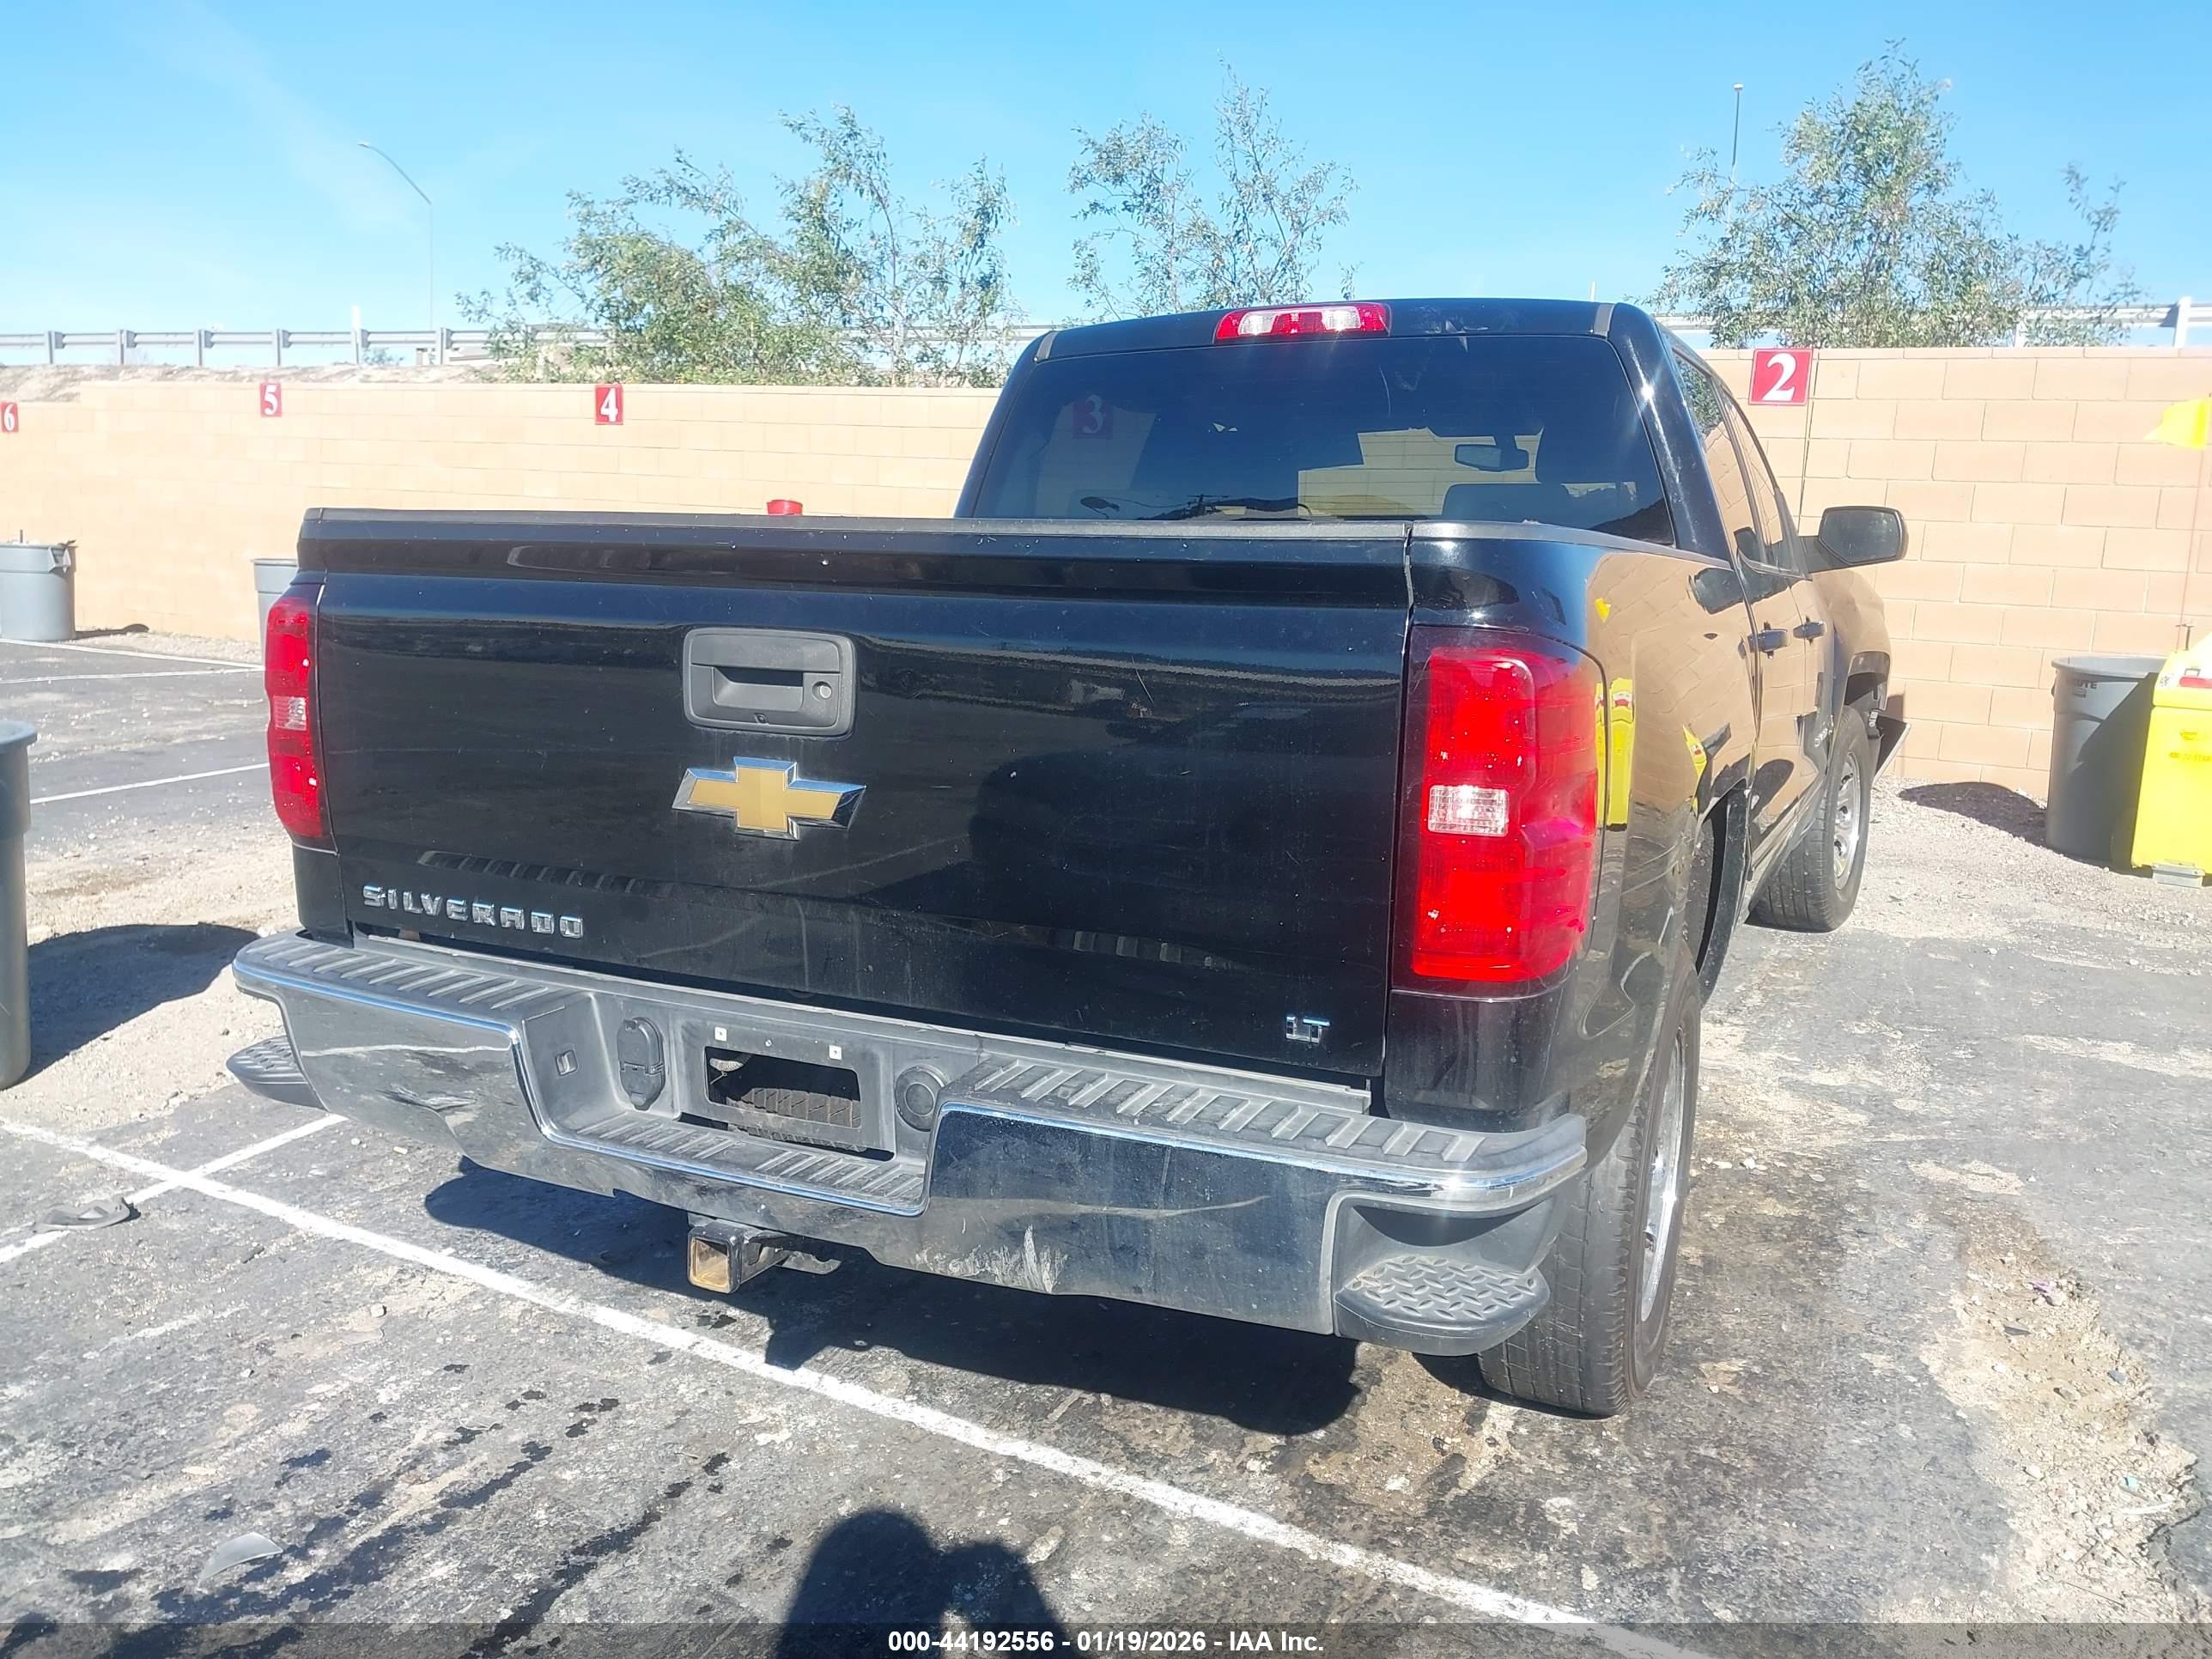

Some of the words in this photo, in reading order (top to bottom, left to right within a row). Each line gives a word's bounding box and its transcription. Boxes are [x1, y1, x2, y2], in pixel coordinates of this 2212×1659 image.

[1761, 352, 1797, 401] 2
[3, 404, 15, 431] 6
[264, 384, 278, 416] 5
[600, 386, 619, 422] 4
[1083, 394, 1103, 434] 3
[362, 884, 583, 939] SILVERADO
[1286, 1016, 1330, 1043] LT
